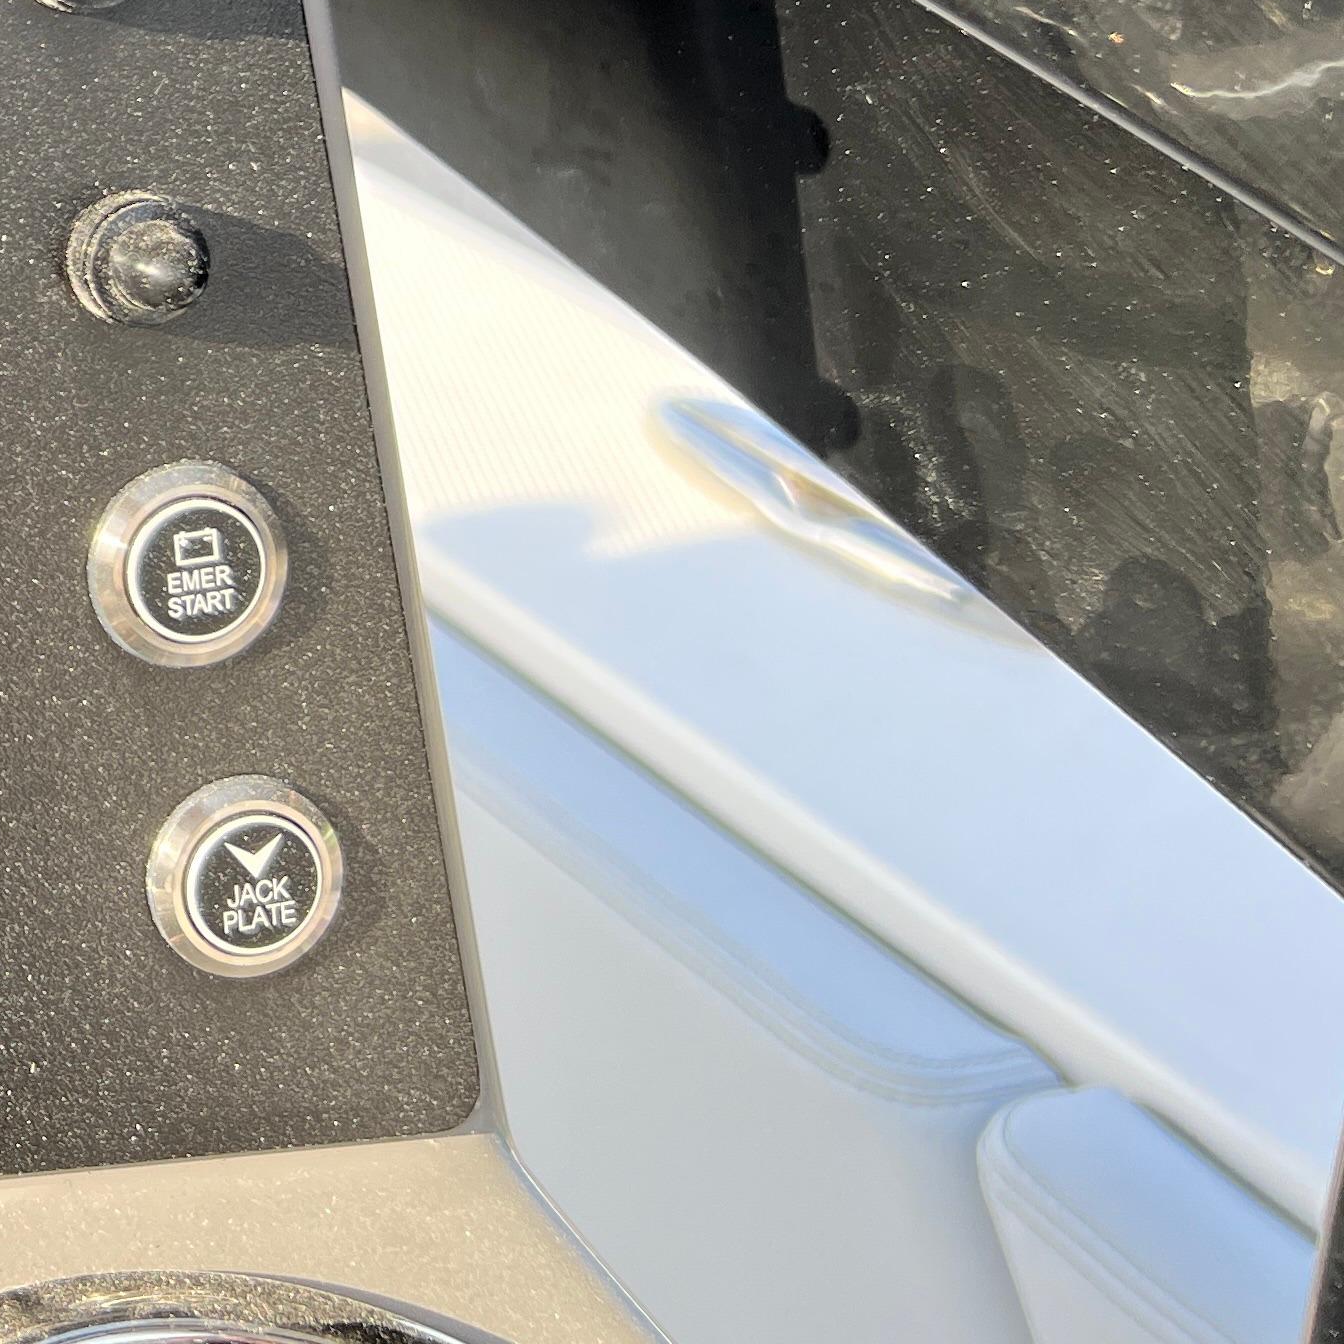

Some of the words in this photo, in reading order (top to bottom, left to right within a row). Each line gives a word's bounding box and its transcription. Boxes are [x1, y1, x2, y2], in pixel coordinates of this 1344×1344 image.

[166, 565, 234, 595] EMER
[167, 588, 235, 619] START
[226, 875, 292, 908] JACK
[223, 900, 297, 935] PLATE
